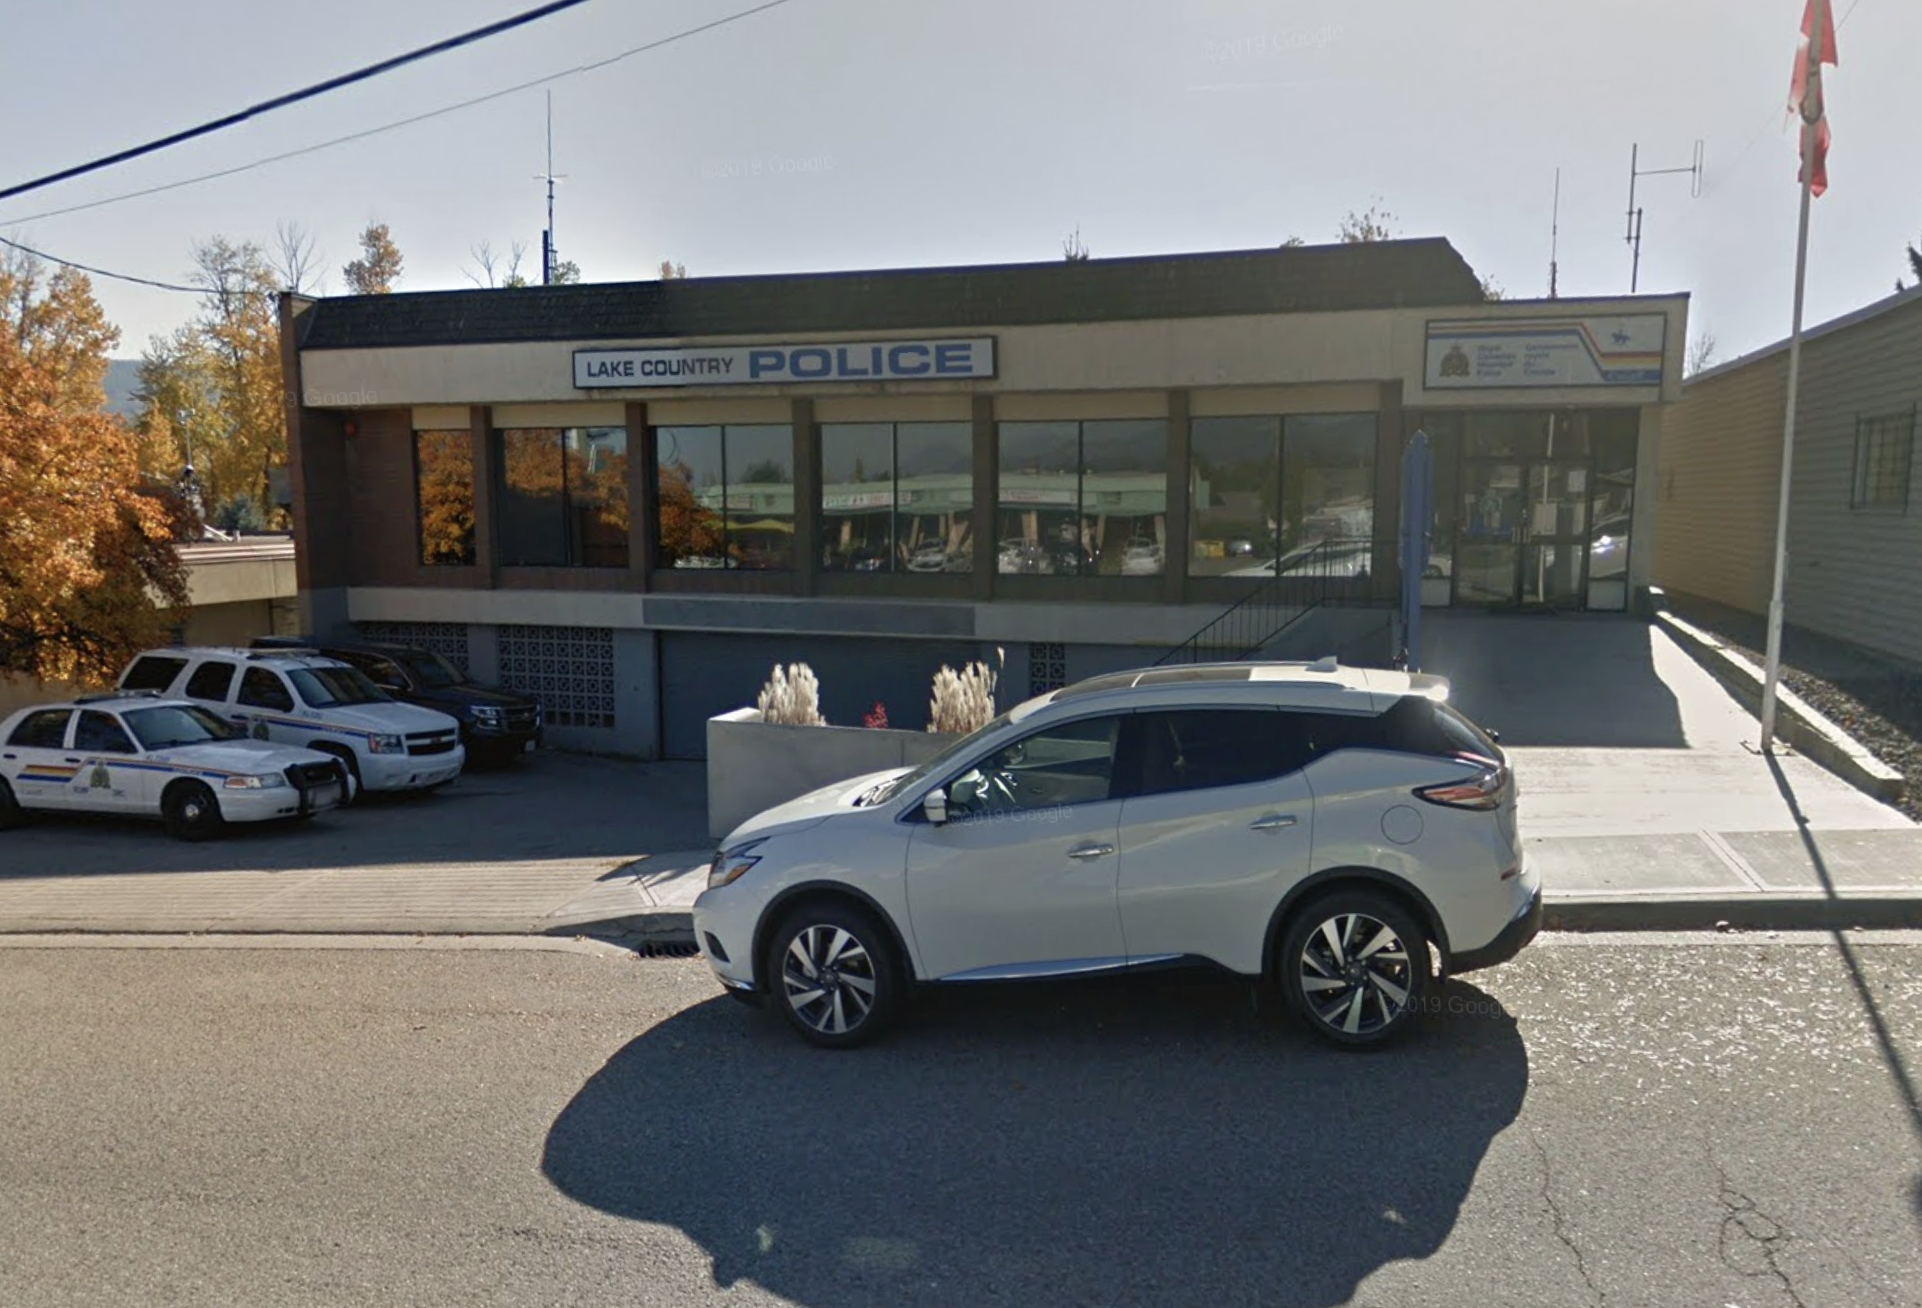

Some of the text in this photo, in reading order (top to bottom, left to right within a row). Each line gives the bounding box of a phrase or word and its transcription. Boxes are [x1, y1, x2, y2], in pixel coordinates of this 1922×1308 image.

[587, 343, 973, 378] LAKE COUNTRY POLICE
